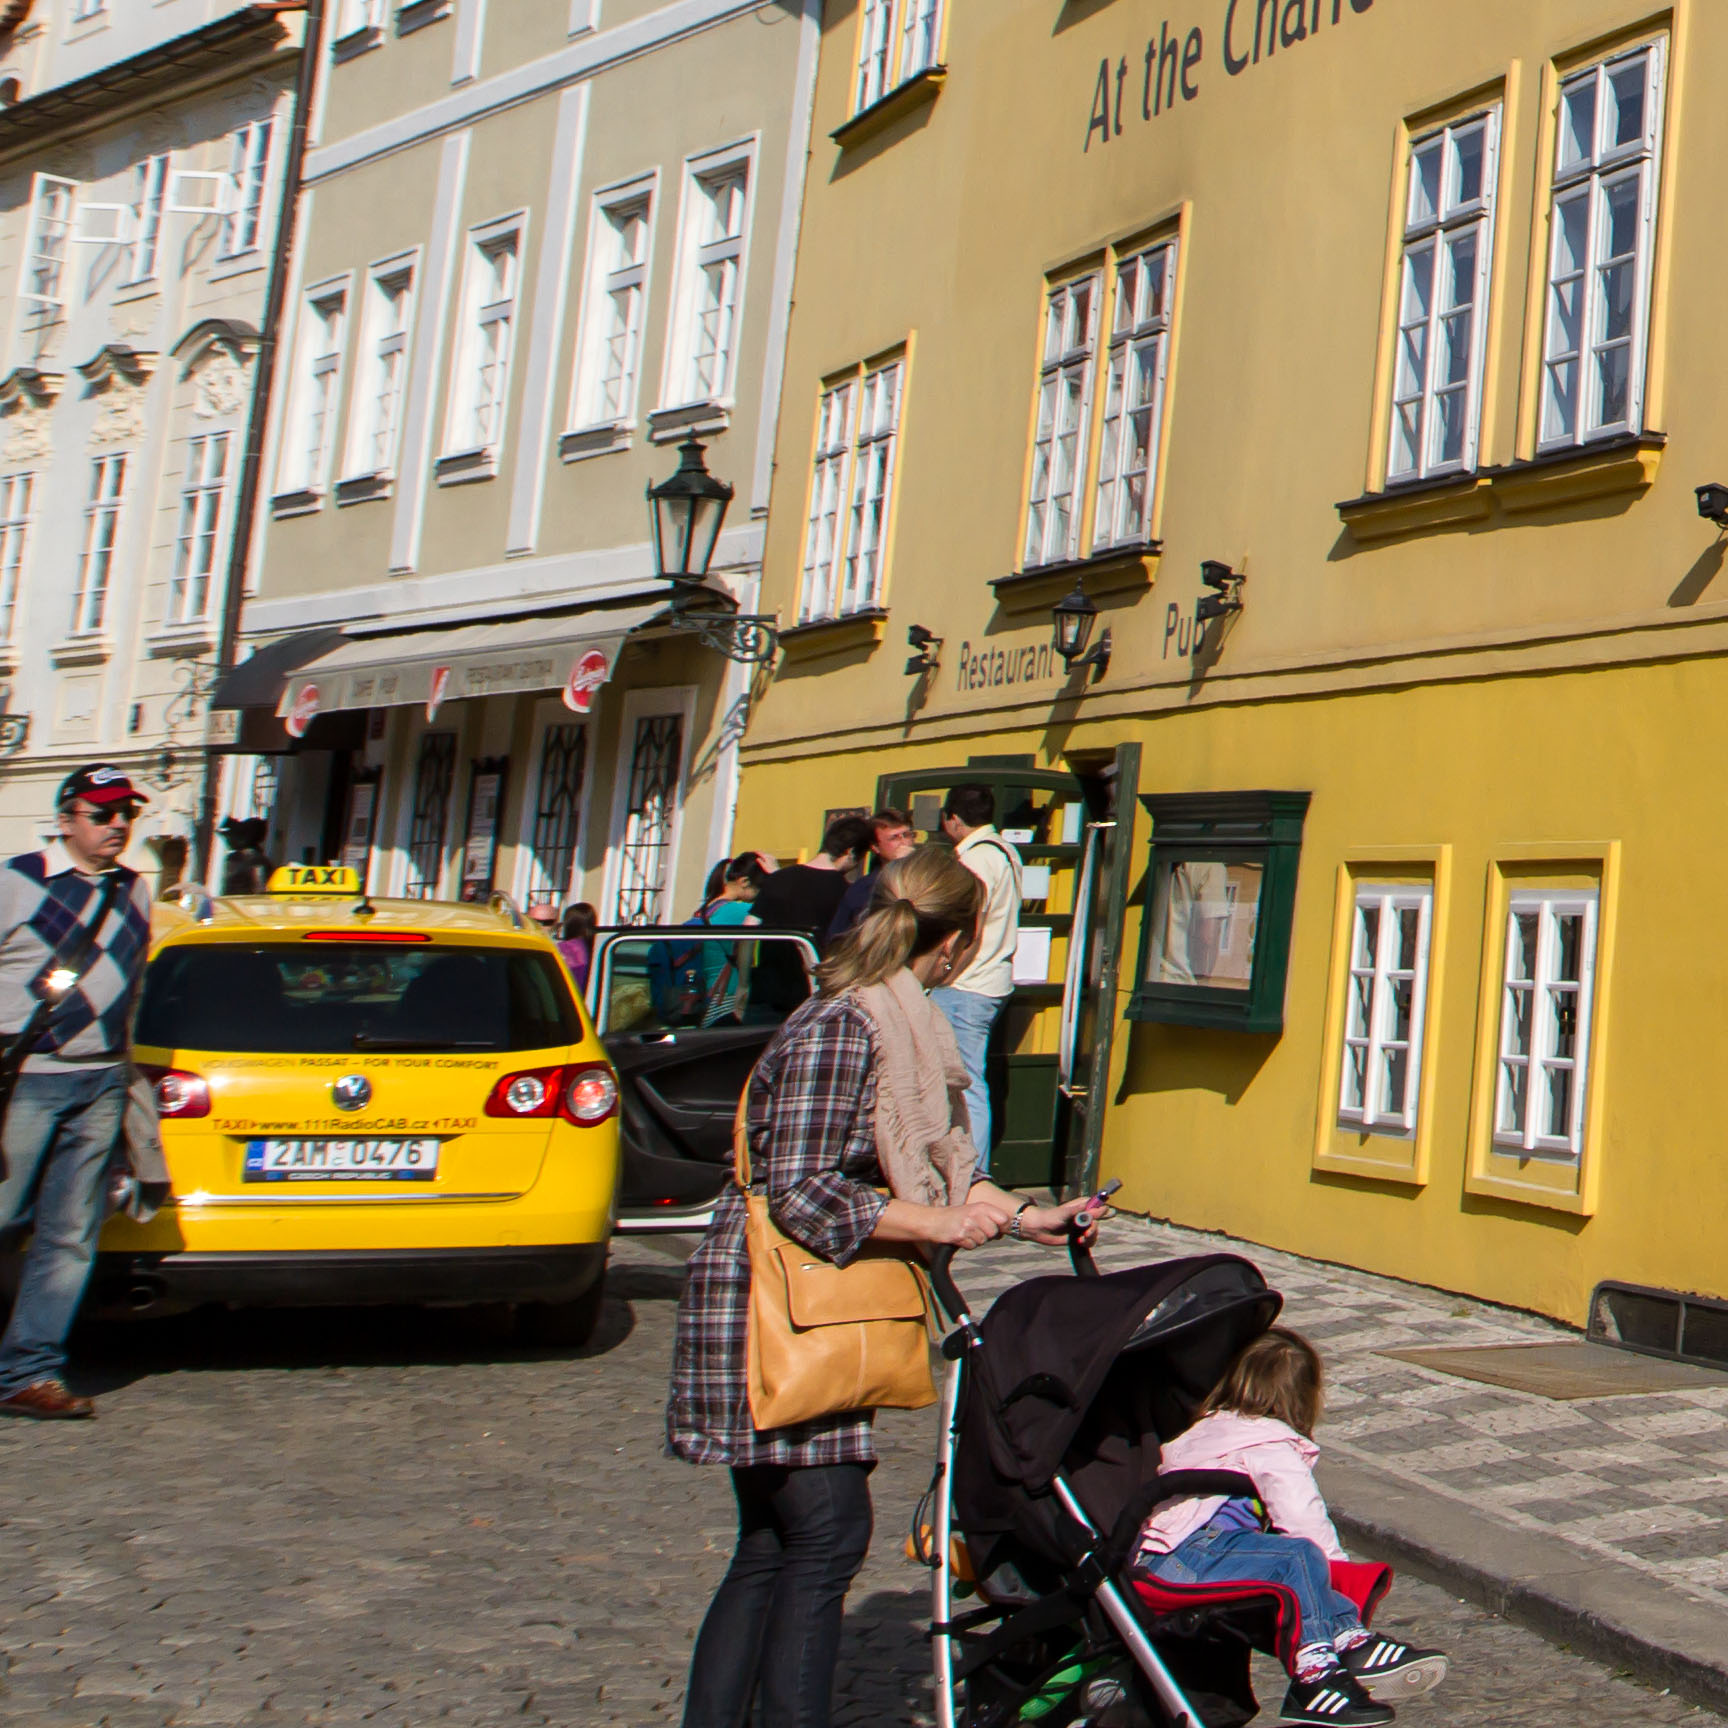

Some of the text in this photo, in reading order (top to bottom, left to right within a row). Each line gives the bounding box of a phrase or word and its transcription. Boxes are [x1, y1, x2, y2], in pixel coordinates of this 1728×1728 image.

[1083, 58, 1127, 153] At
[1142, 20, 1202, 122] the
[288, 867, 347, 886] TAXI
[300, 1057, 350, 1067] PASSAT
[363, 1058, 391, 1067] FOR
[394, 1059, 432, 1068] YOUR
[434, 1058, 499, 1070] COMFORT
[352, 1139, 422, 1166] 0476
